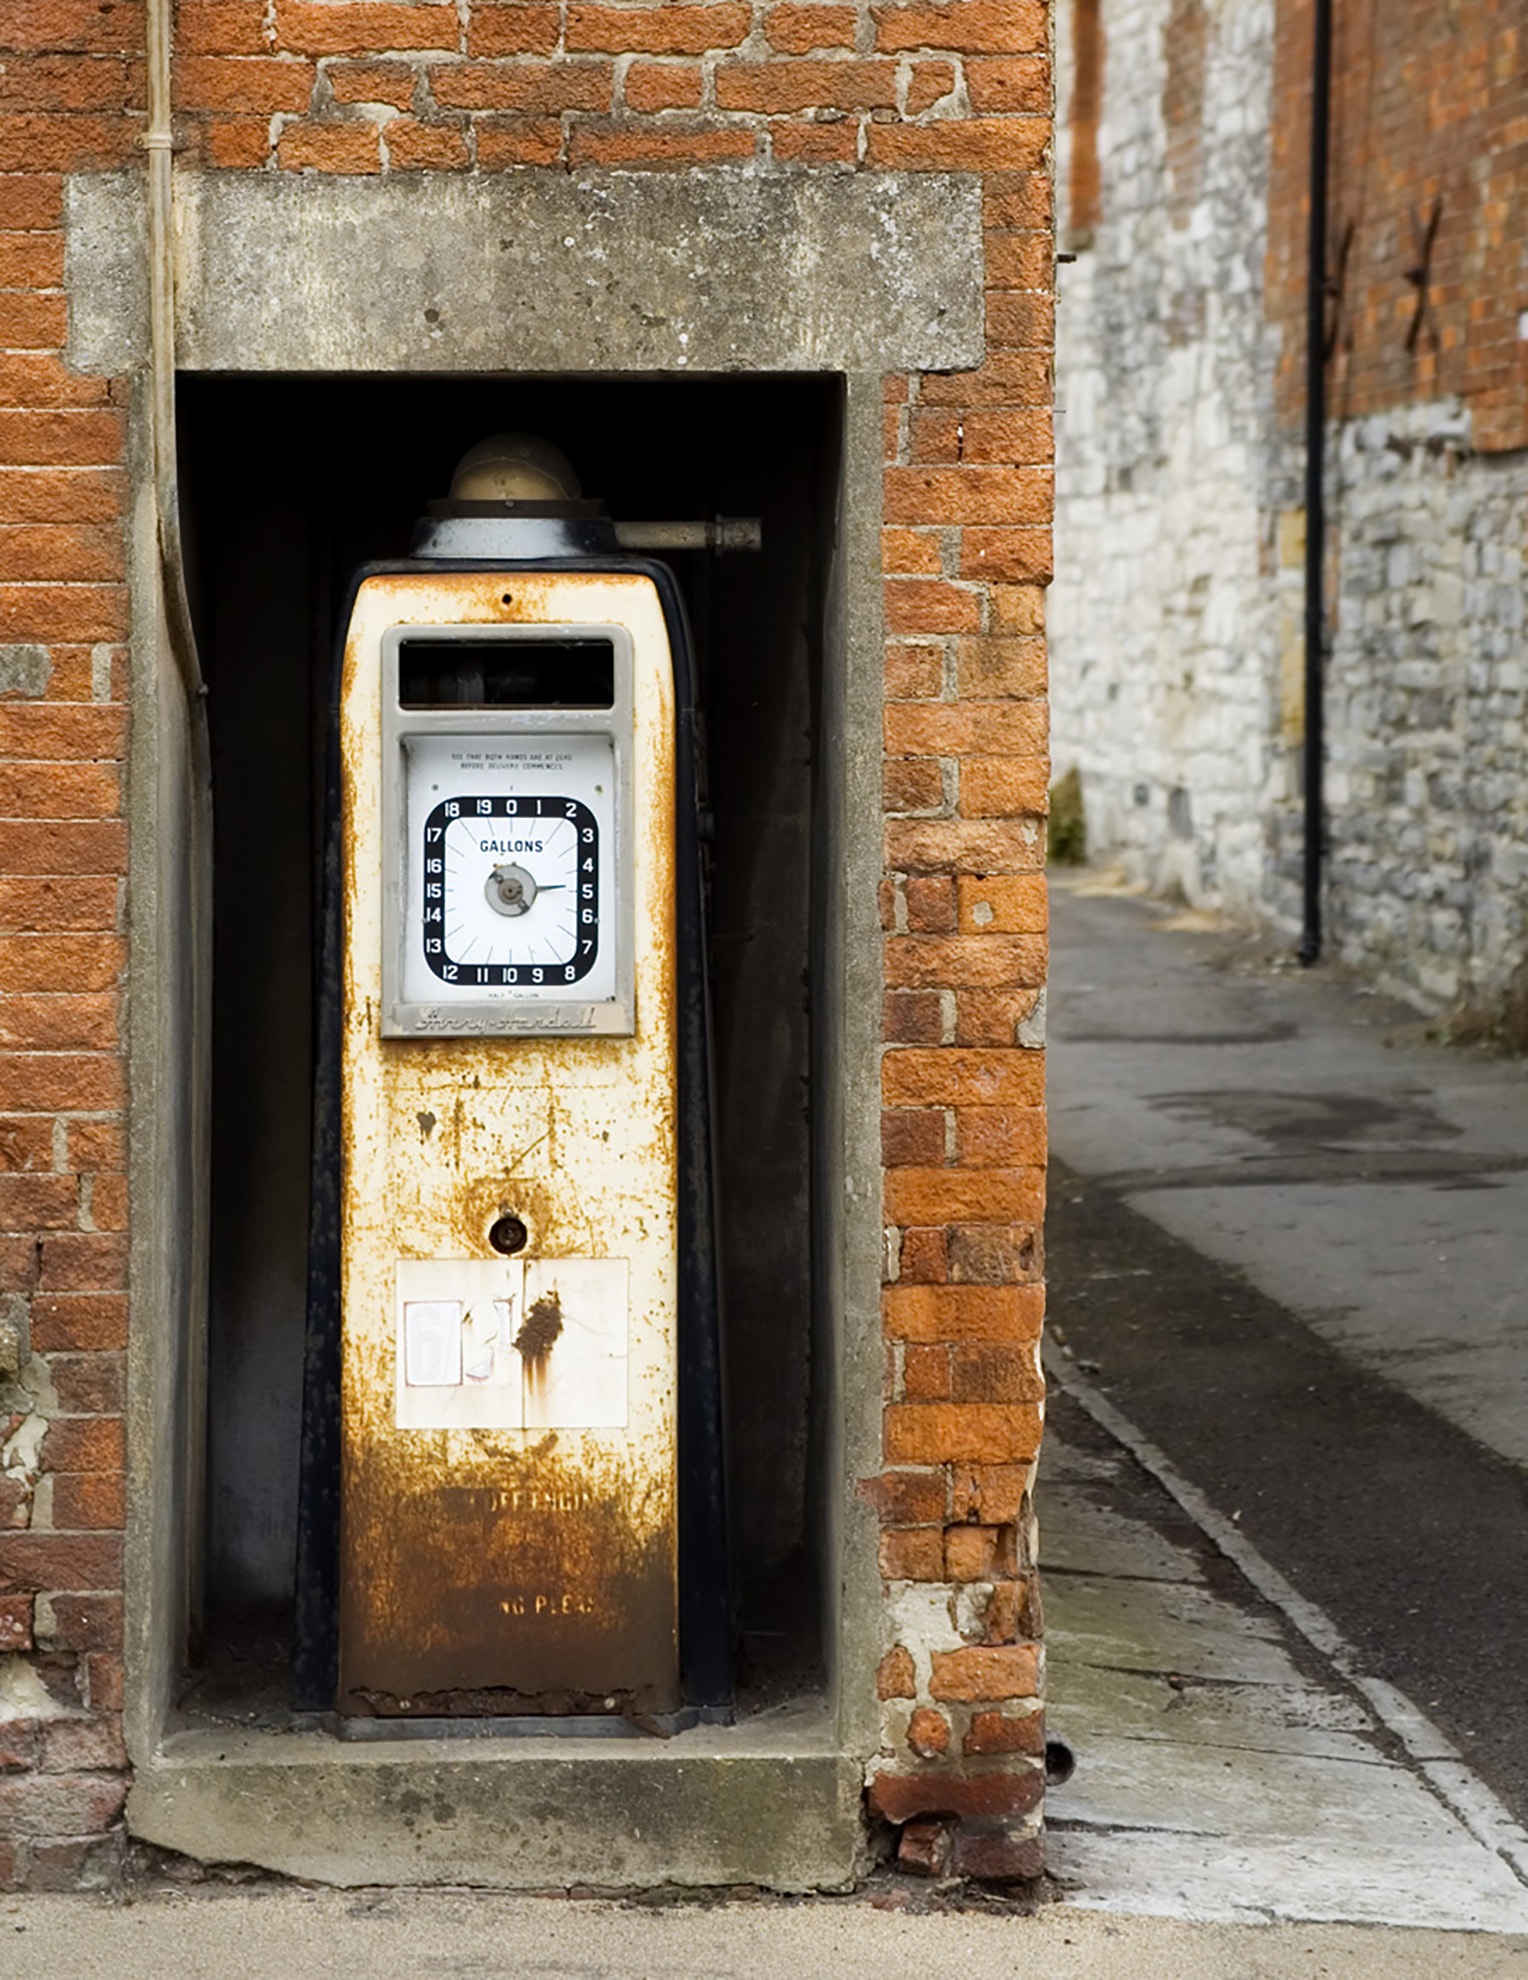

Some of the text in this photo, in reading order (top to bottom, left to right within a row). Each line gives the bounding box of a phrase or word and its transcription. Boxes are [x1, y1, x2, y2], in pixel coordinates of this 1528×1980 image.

[466, 753, 482, 761] THAT
[485, 753, 503, 761] BOTH
[506, 753, 528, 761] HANDS
[530, 753, 543, 761] ARE
[545, 753, 554, 761] AT
[555, 753, 573, 761] ZERO
[460, 762, 484, 770] BEFORE
[488, 762, 519, 770] DELIVERY
[444, 799, 577, 818] 18 19 0 1 2
[426, 827, 443, 843] 17
[582, 827, 594, 843] 3
[479, 839, 543, 853] GALLONS
[426, 858, 443, 874] 16
[582, 857, 594, 873] 4
[426, 882, 442, 899] 15
[581, 883, 594, 900] 5
[426, 907, 442, 923] 14
[581, 908, 594, 924] 6
[426, 938, 442, 954] 13
[581, 939, 593, 955] 7
[442, 964, 576, 984] 12 11 10 9 8
